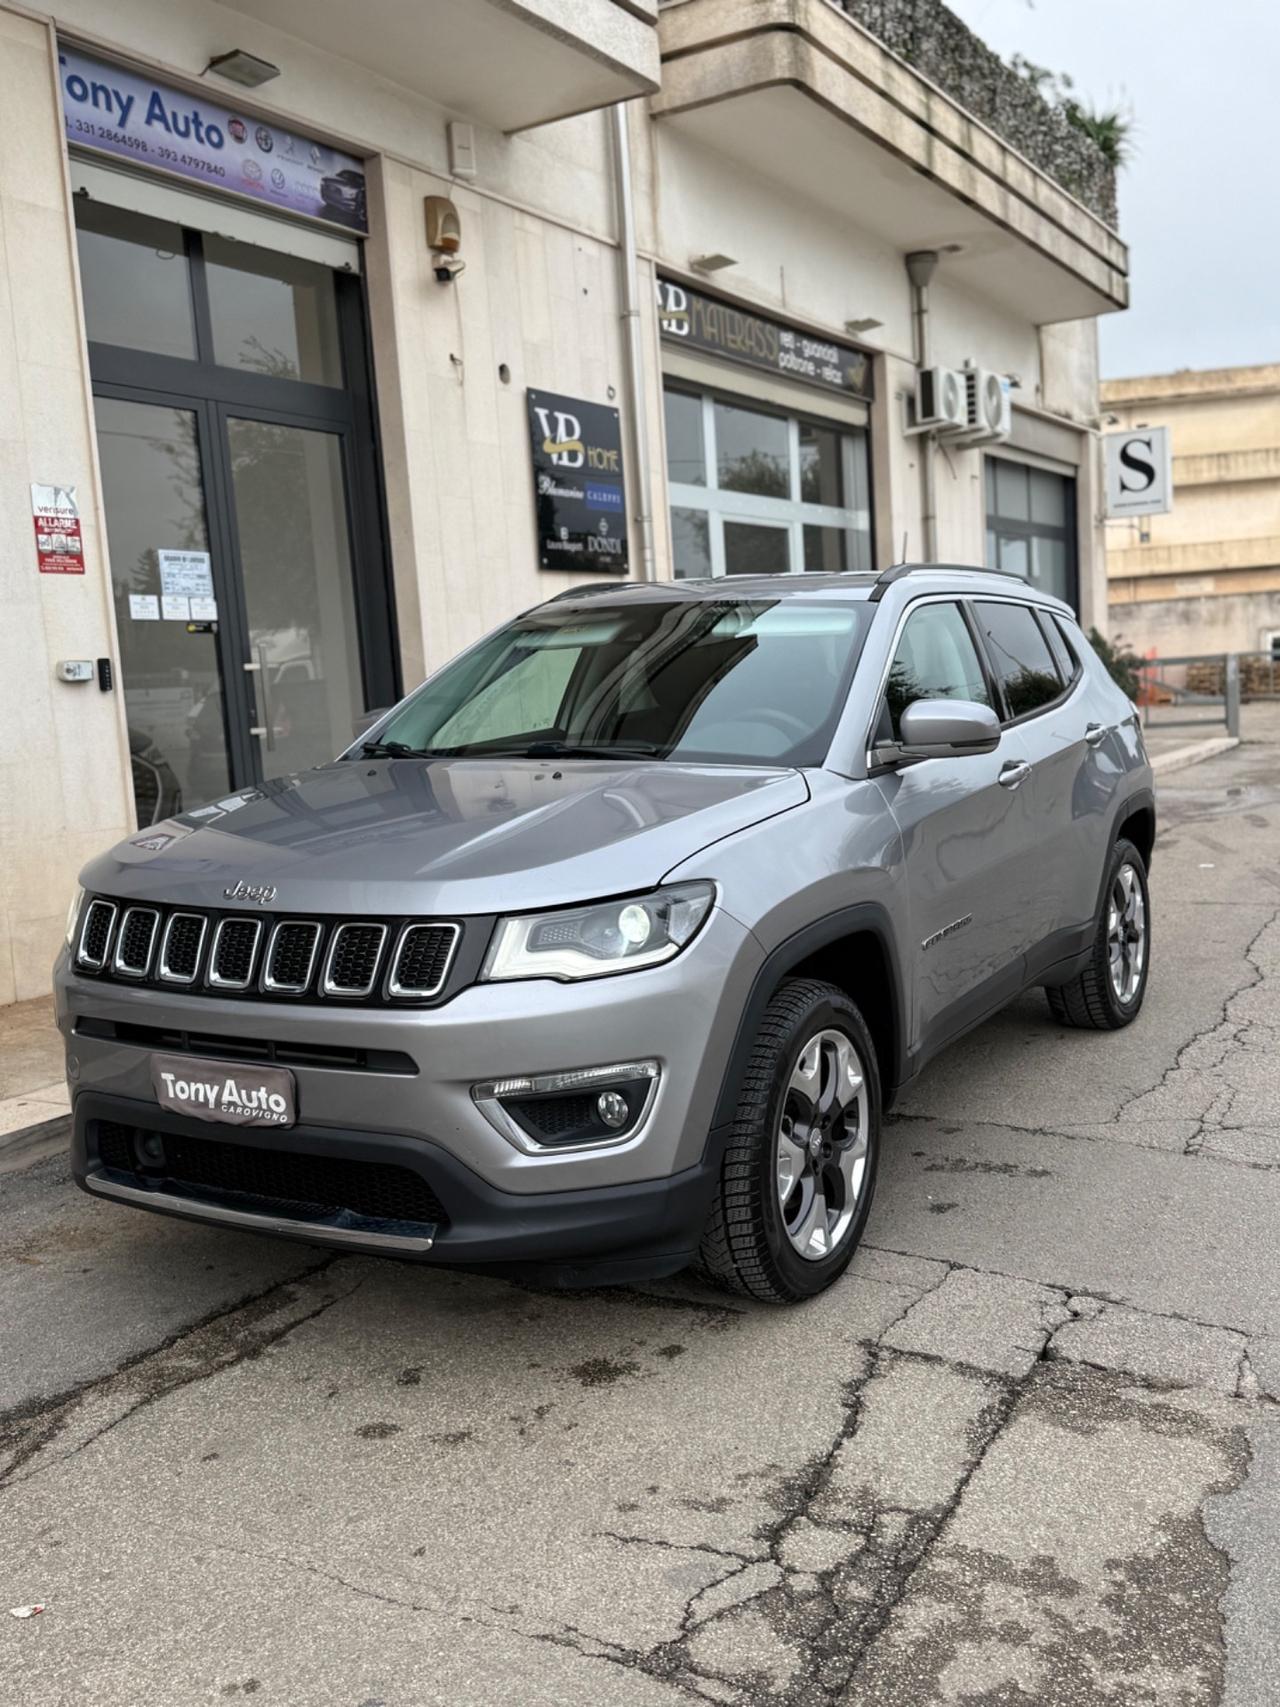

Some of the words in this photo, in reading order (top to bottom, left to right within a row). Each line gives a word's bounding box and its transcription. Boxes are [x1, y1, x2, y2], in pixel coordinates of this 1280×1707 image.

[58, 55, 134, 128] ony
[144, 90, 224, 149] Auto
[75, 119, 95, 135] 331
[98, 126, 148, 152] 2864598
[158, 146, 178, 162] 393
[180, 154, 226, 177] 4797840
[691, 295, 779, 360] MATERASSI
[587, 445, 620, 472] HOME
[1119, 436, 1155, 495] S
[38, 505, 75, 515] verisure
[38, 516, 77, 529] ALLARME
[223, 880, 277, 905] Jeep
[160, 1072, 220, 1109] Tony
[221, 1079, 287, 1113] Auto
[221, 1104, 288, 1123] CAROVIGNO
